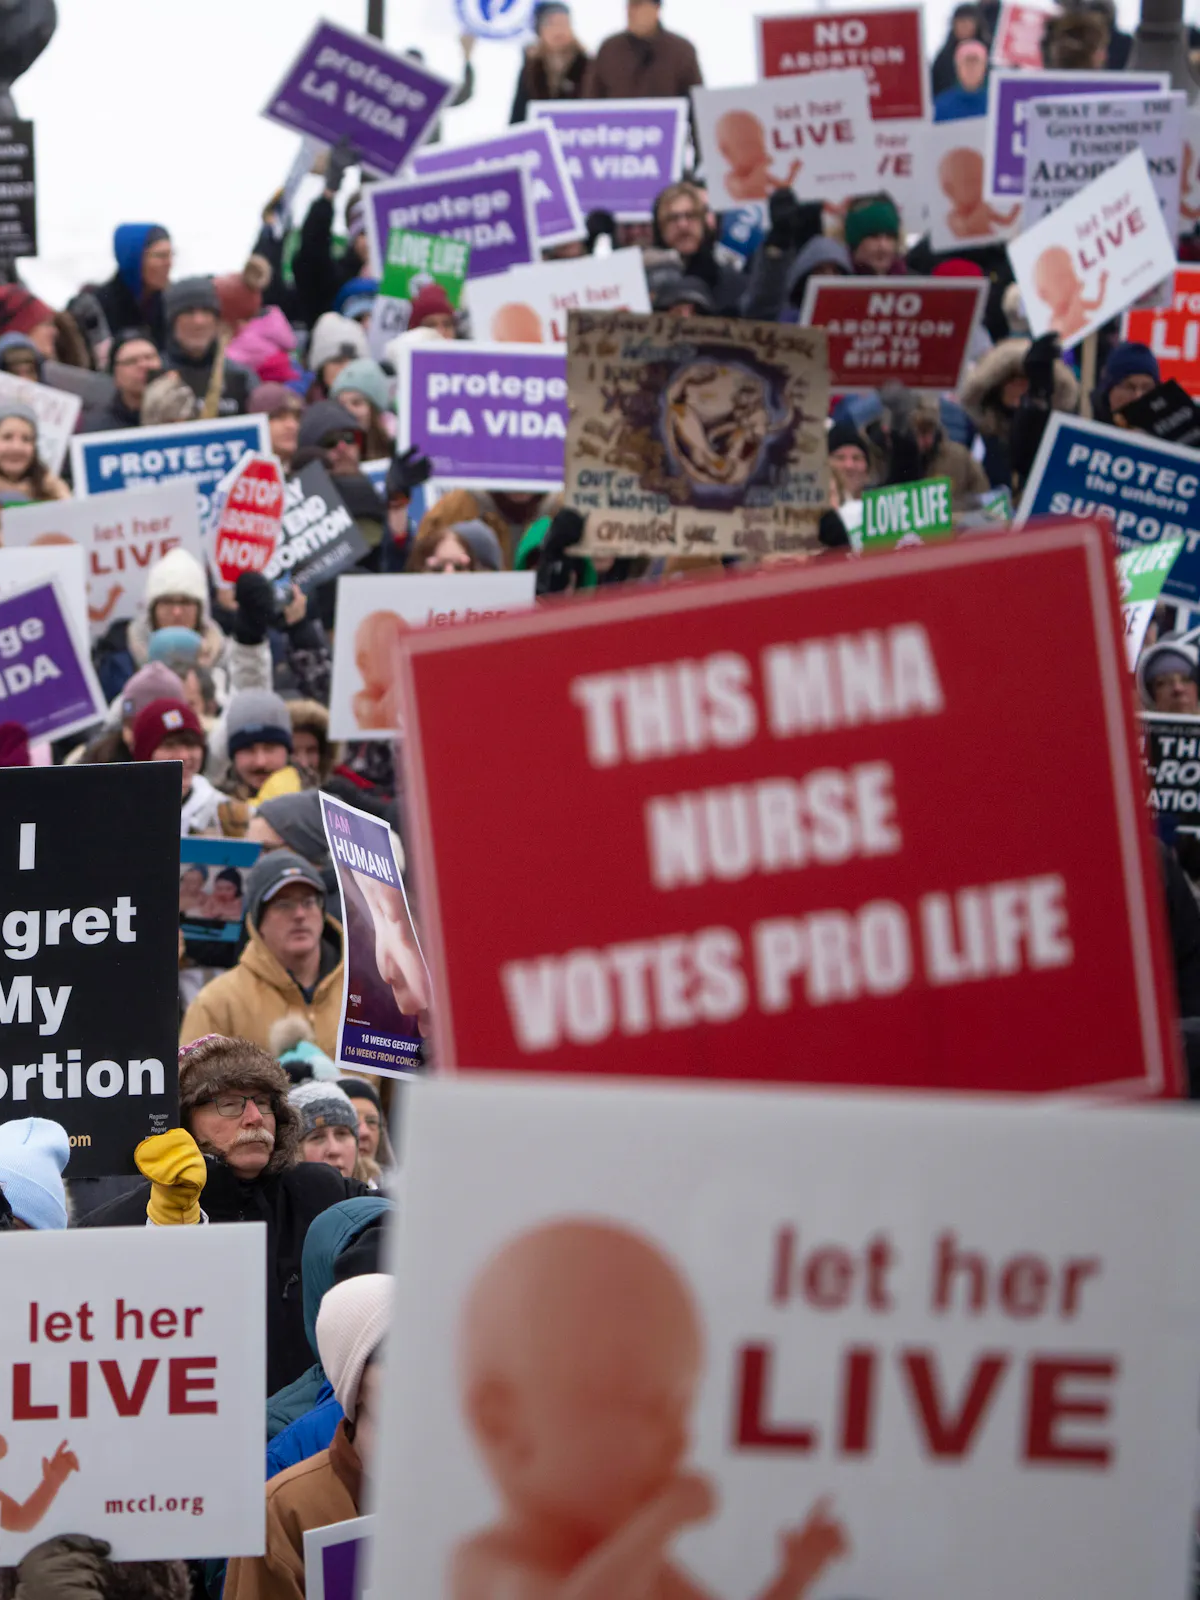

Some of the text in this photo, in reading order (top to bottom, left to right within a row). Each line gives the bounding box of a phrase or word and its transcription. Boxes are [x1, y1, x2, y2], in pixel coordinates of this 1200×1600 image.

[813, 20, 867, 47] NO
[779, 45, 906, 72] ABORTION
[314, 46, 429, 113] protege
[298, 70, 410, 140] LA VIDA
[773, 98, 845, 119] let her
[1035, 102, 1090, 118] WHAT
[550, 124, 664, 148] protege
[771, 119, 856, 151] LIVE
[1045, 119, 1164, 139] GOVERNMENT
[590, 154, 661, 178] VIDA
[388, 188, 513, 234] protege
[1078, 207, 1147, 271] LIVE
[867, 292, 923, 318] NO
[826, 319, 954, 338] ABORTION
[852, 335, 920, 352] UP TO
[842, 351, 922, 369] BIRTH
[426, 371, 568, 404] protege
[426, 409, 567, 439] LA VIDA
[100, 438, 246, 479] PROTECT
[1066, 442, 1200, 499] PROTEC
[233, 477, 281, 506] STOP
[1085, 471, 1190, 515] the unborn
[865, 489, 915, 537] LOVE
[916, 482, 950, 527] LIFE
[94, 514, 172, 541] let her
[263, 503, 353, 579] BORTION
[219, 536, 273, 567] NOW
[570, 620, 947, 770] THIS MNA
[328, 809, 351, 836] I AM
[644, 757, 903, 892] NURSE
[18, 822, 37, 871] I
[332, 835, 396, 884] HUMAN!
[500, 871, 1075, 1055] VOTES PRO LIFE
[345, 1045, 395, 1063] (16 WEEKS FROM
[361, 1034, 370, 1044] 18
[370, 1035, 392, 1047] WEEKS
[768, 1217, 1102, 1325] let her
[29, 1298, 204, 1343] let her
[12, 1356, 219, 1421] LIVE
[730, 1336, 1124, 1476] LIVE
[105, 1494, 205, 1517] mccl.org
